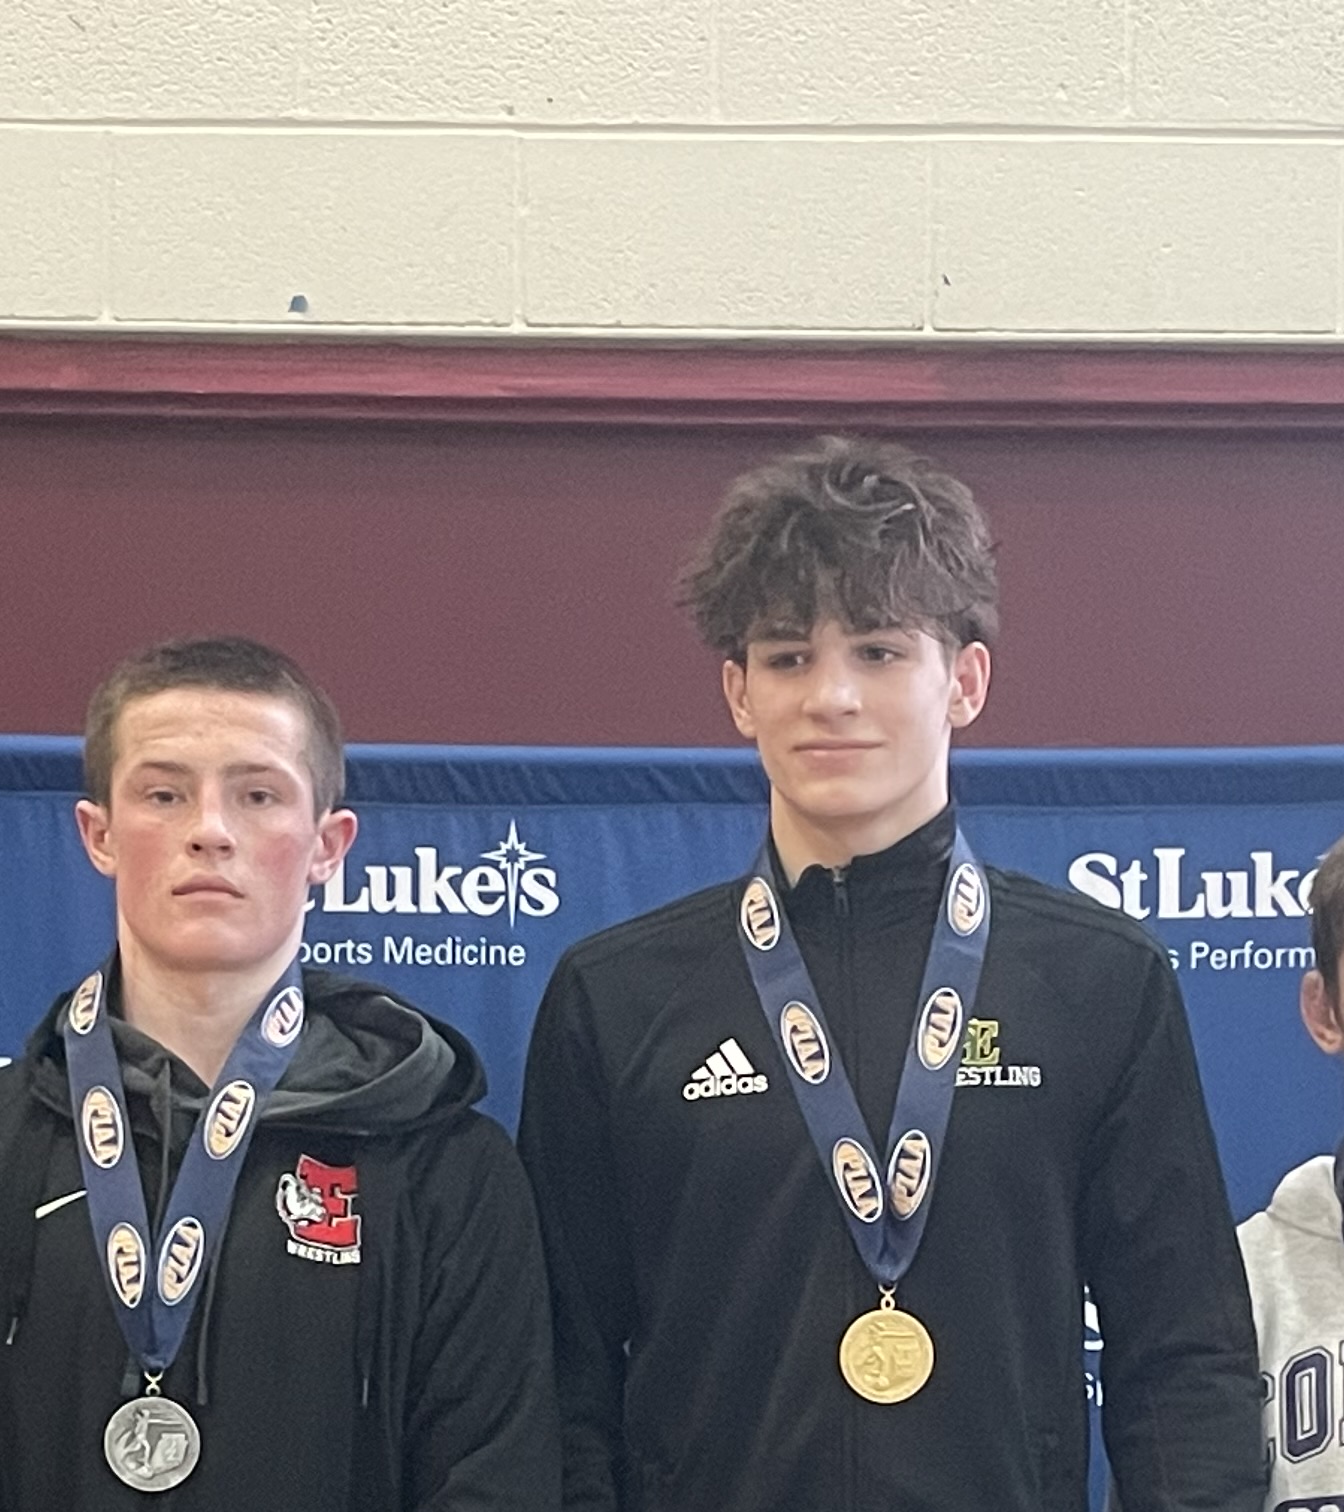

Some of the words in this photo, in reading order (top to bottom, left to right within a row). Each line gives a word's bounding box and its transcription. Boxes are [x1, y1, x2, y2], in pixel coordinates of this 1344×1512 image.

[384, 937, 526, 966] Medicine
[1191, 941, 1315, 970] Perform
[683, 1072, 769, 1101] adidas
[955, 1065, 1041, 1088] ESTLING
